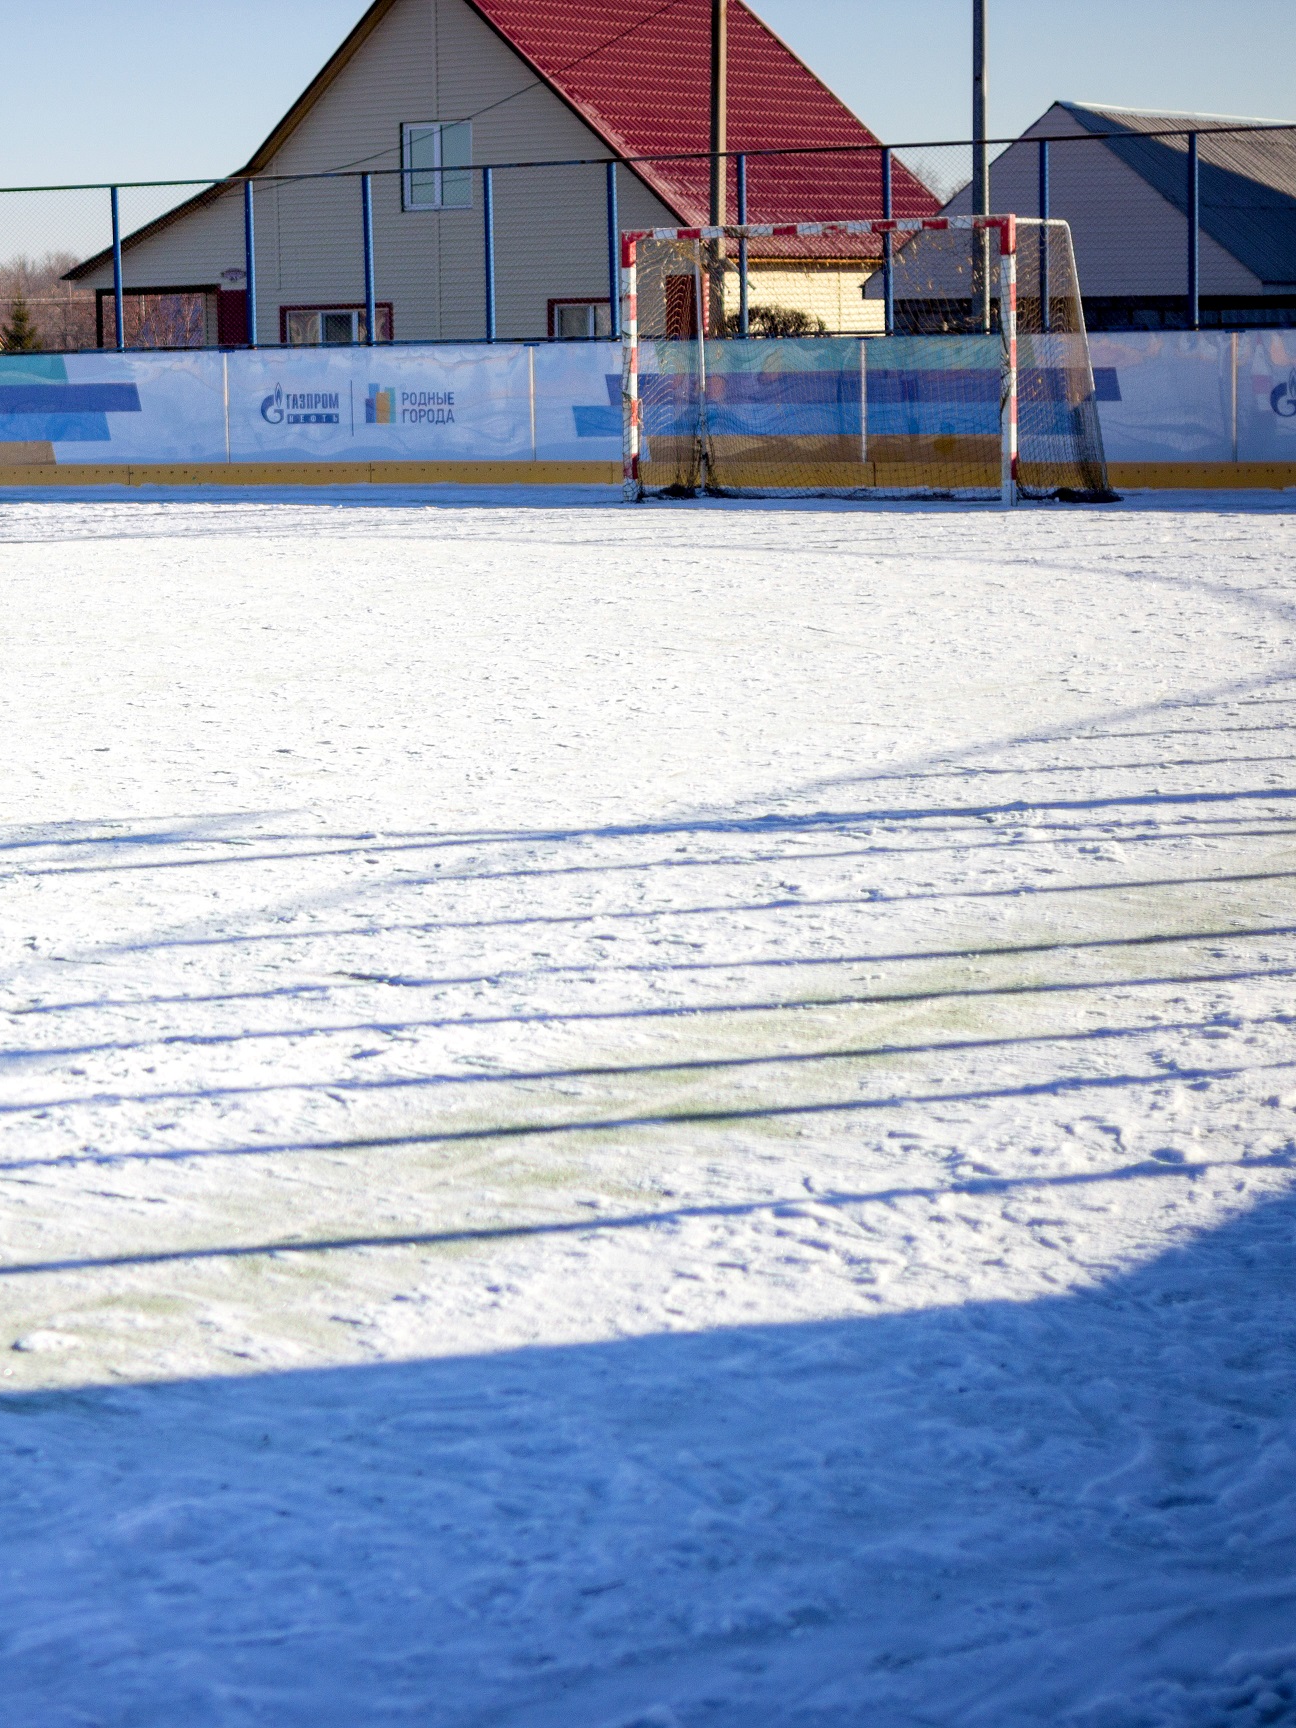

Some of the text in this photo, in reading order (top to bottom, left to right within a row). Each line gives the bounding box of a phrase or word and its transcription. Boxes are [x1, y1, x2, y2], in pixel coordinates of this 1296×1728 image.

[286, 393, 339, 409] ГАЗПРОМ
[402, 391, 454, 406] РОДНЫЕ
[288, 414, 339, 424] НЕФТЬ
[402, 409, 455, 424] ГОРОДА
